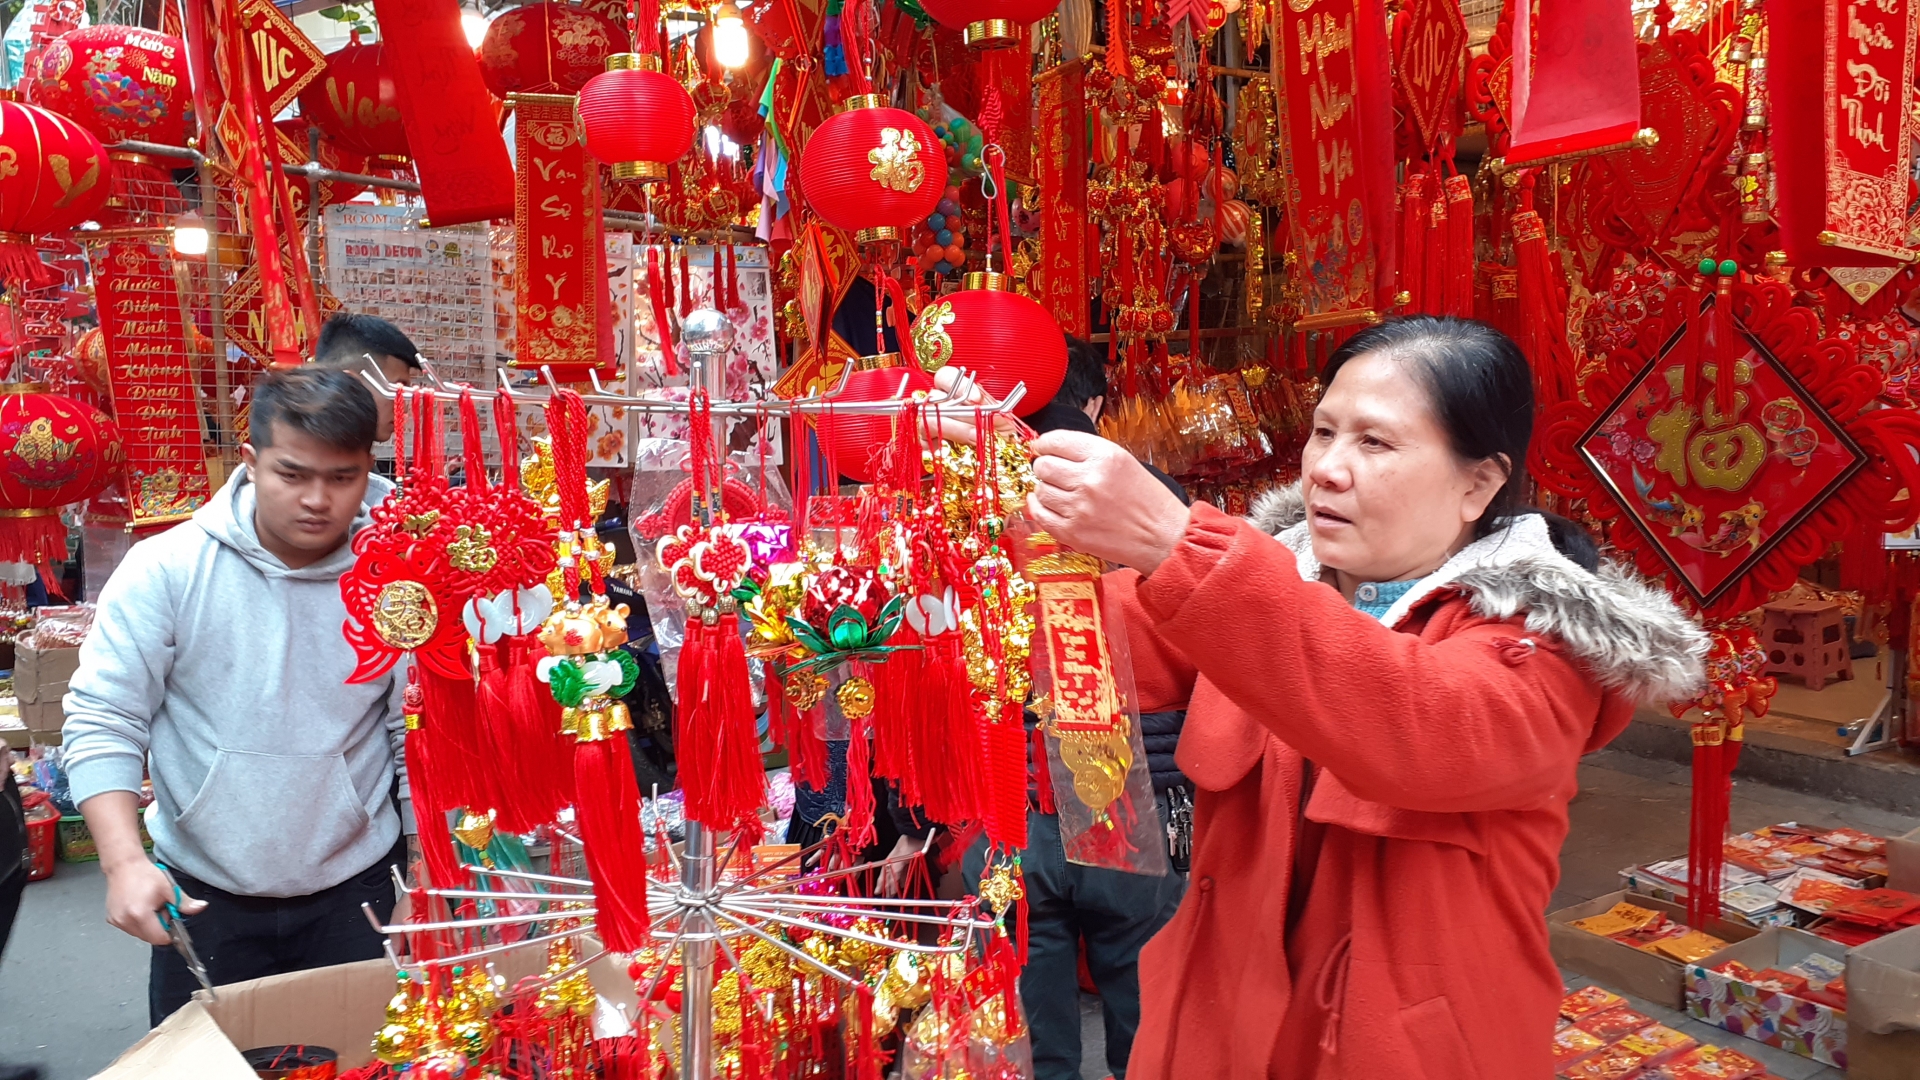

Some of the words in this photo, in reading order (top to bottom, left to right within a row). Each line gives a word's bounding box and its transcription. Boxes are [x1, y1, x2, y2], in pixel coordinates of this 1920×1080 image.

[142, 66, 177, 88] Năm
[533, 156, 577, 184] Vạn
[868, 127, 925, 193] 福
[343, 214, 388, 224] ROOM
[540, 194, 572, 221] Sự
[345, 245, 380, 257] ROOM
[384, 246, 422, 258] DECOR
[541, 234, 574, 259] Như
[545, 271, 568, 301] Ý
[116, 319, 170, 337] Mênh
[117, 363, 183, 380] Không
[1646, 358, 1768, 492] 福
[154, 444, 180, 461] Mẹ
